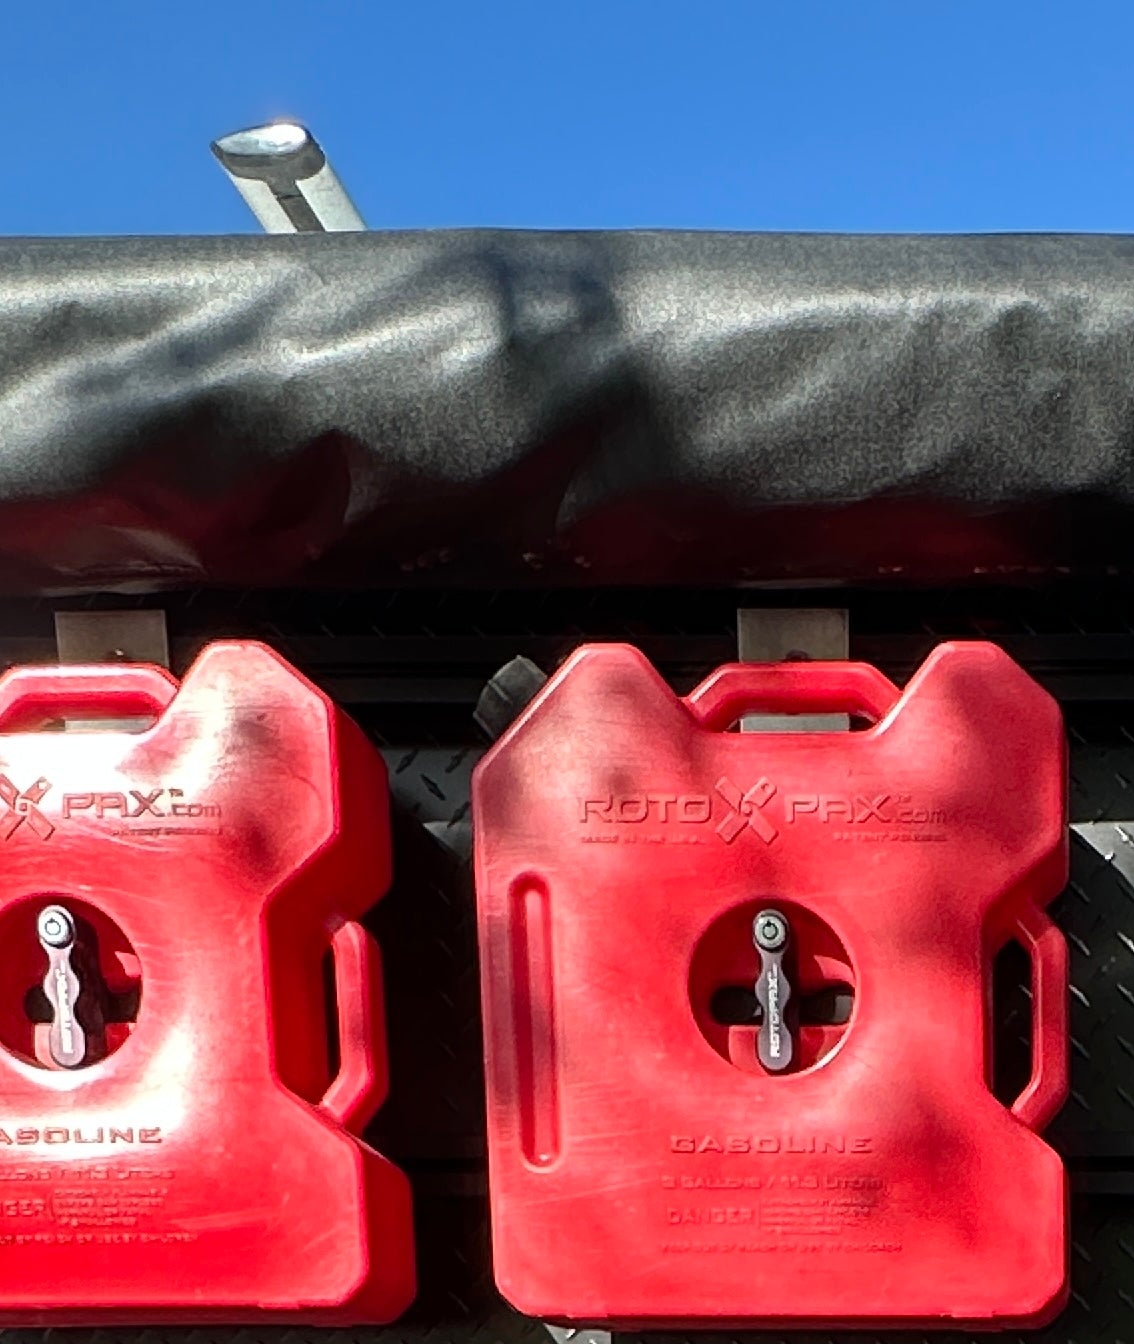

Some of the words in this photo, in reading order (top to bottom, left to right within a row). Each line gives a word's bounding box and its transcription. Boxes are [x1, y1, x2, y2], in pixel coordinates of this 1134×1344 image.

[577, 794, 713, 824] ROTO
[670, 1134, 873, 1154] GASOLINE
[667, 1208, 752, 1225] DANGER
